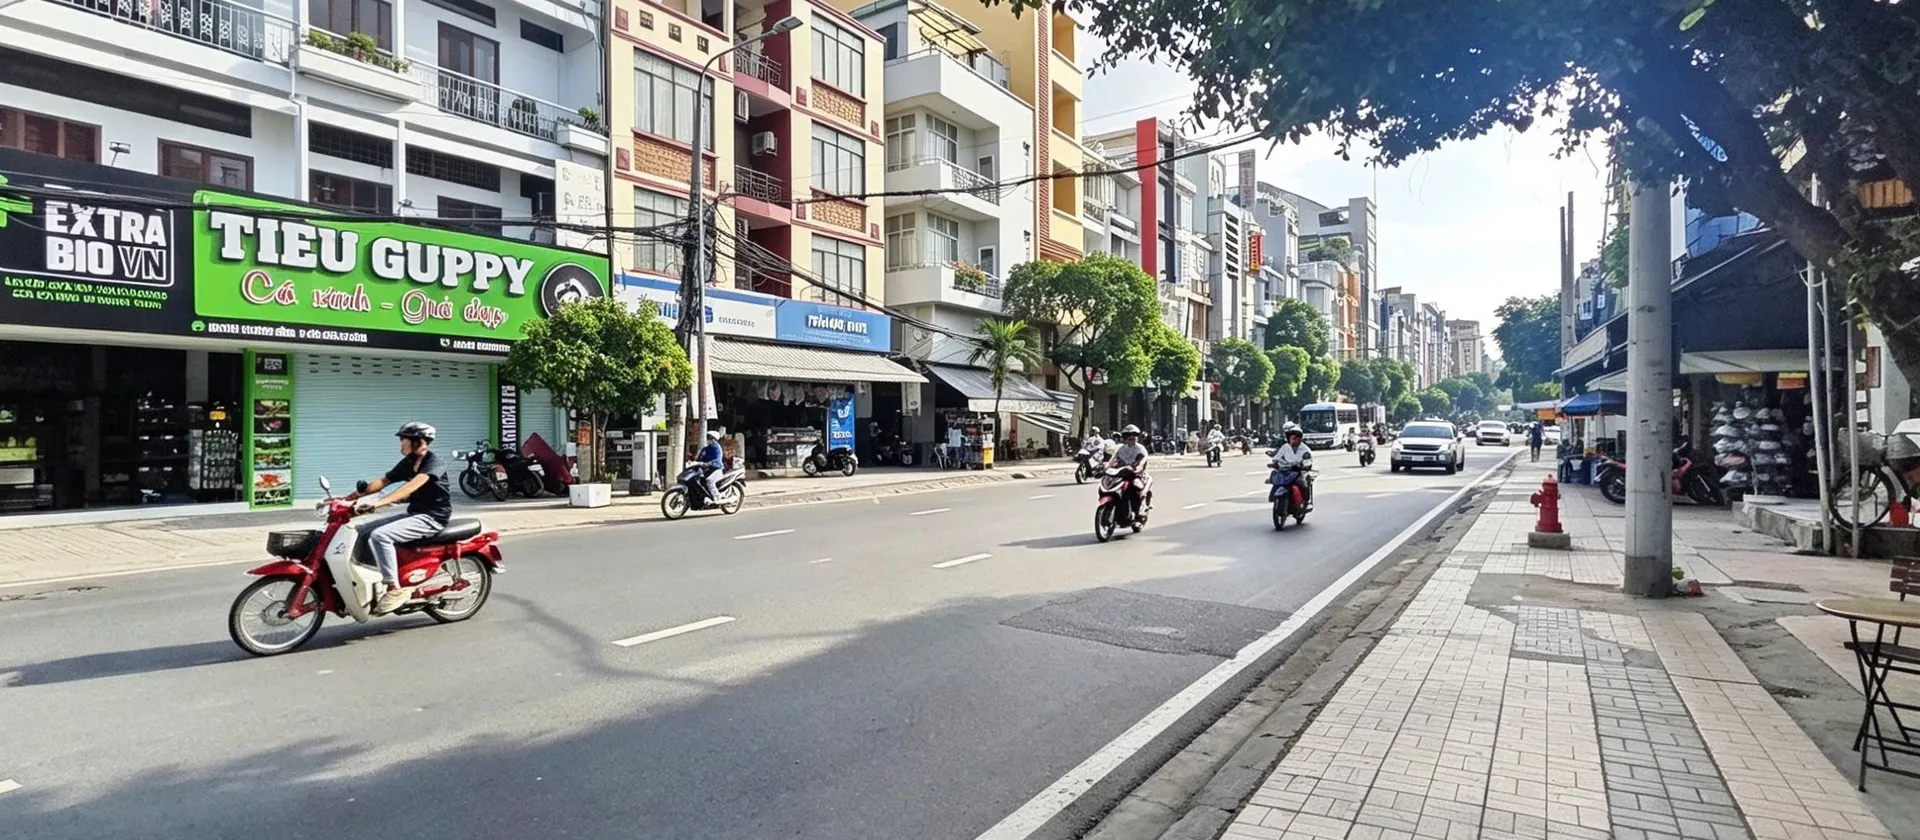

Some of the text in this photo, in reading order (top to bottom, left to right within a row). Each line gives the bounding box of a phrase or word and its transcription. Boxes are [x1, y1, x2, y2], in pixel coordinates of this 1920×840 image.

[45, 200, 167, 246] EXTRA
[46, 236, 166, 281] BIO VN
[371, 237, 536, 296] GUPPY
